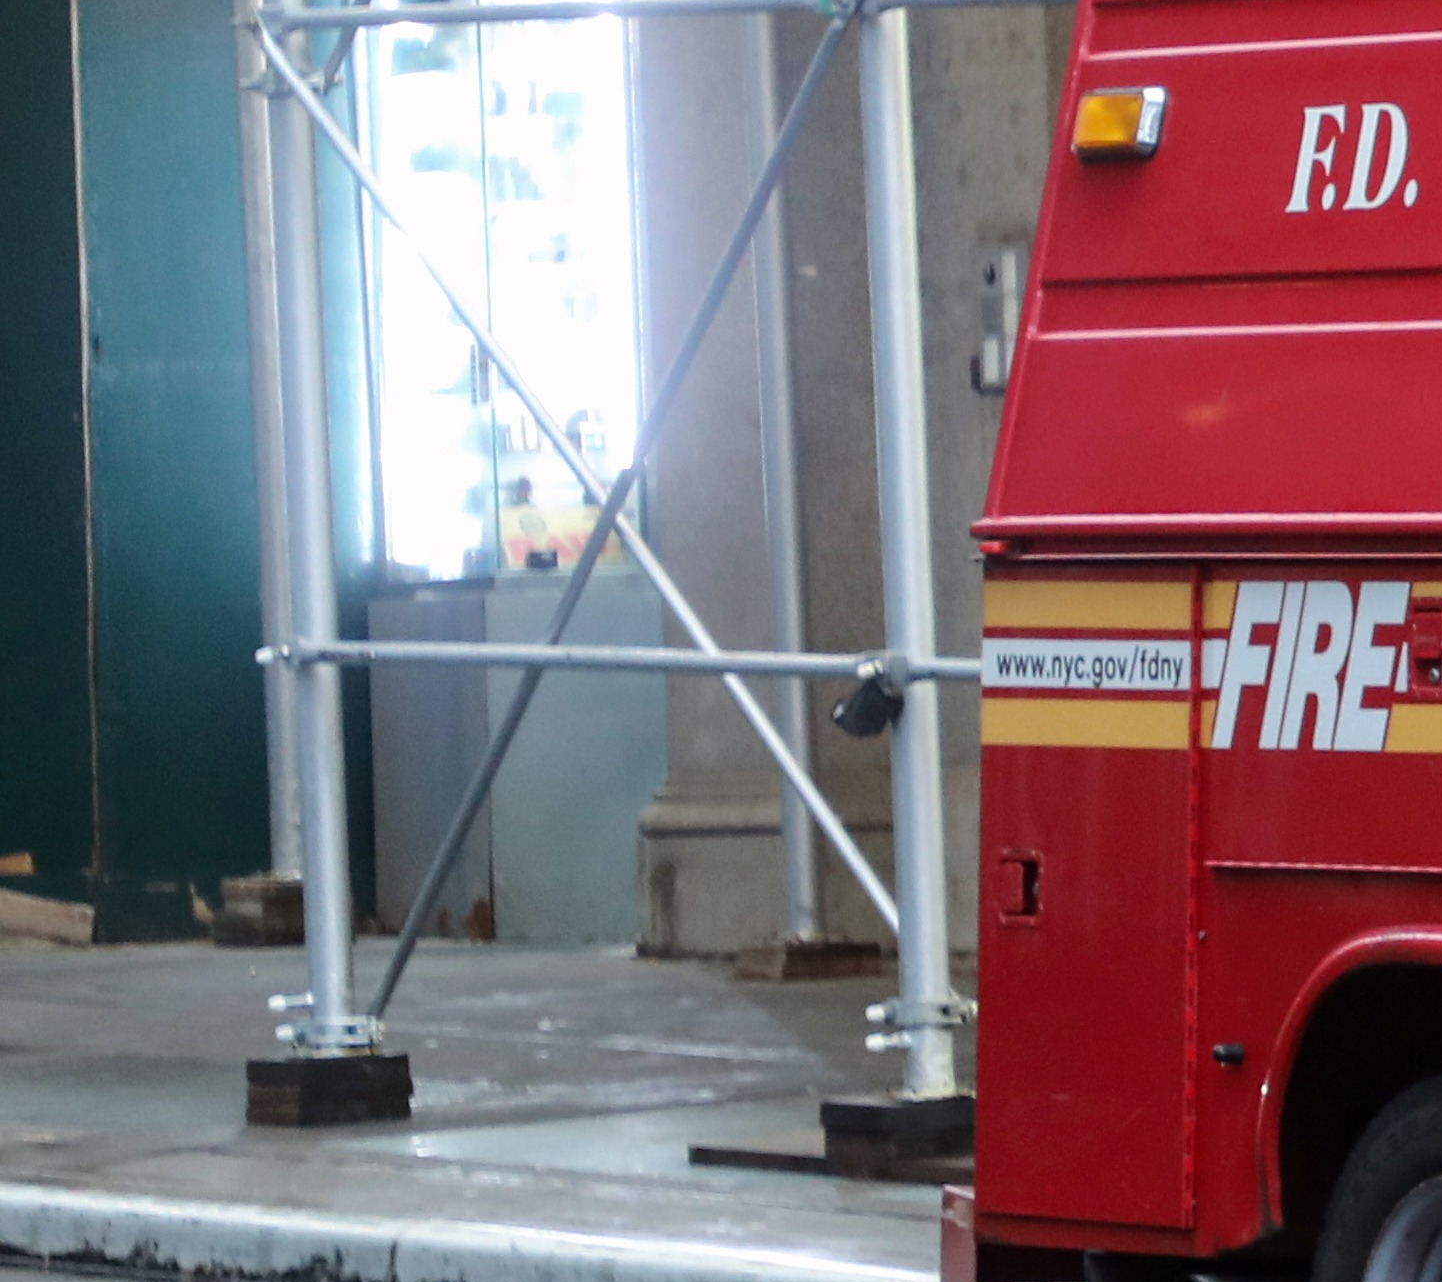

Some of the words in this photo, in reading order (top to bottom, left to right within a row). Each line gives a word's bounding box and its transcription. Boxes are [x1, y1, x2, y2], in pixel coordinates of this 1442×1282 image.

[1285, 102, 1419, 214] F.D.
[995, 644, 1186, 688] www.nyc.gov/fdny
[1210, 580, 1412, 752] FIRE
